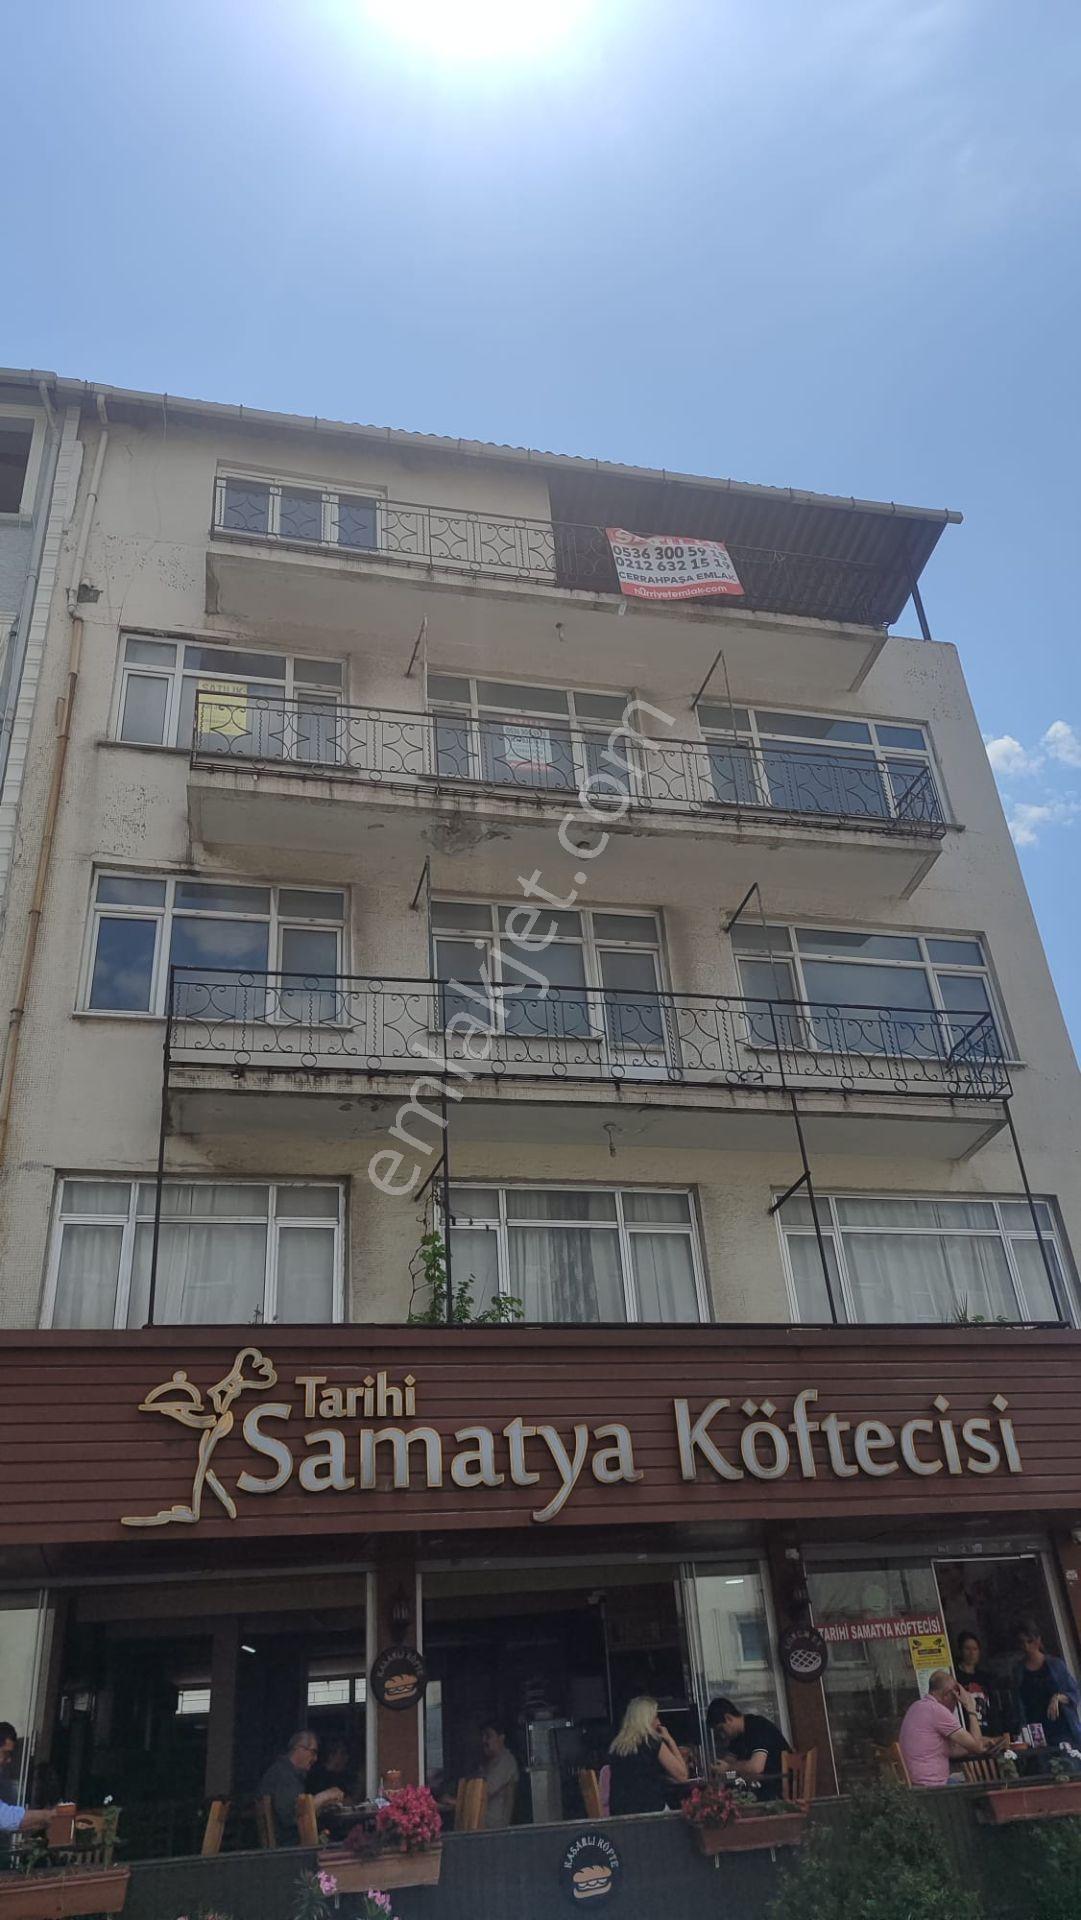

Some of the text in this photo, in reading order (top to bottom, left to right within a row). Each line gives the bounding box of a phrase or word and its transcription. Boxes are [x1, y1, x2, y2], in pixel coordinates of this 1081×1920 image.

[613, 545, 651, 560] 0536
[654, 546, 684, 560] 300
[688, 546, 706, 557] 59
[616, 556, 654, 571] 0212
[657, 560, 687, 571] 632
[691, 557, 710, 570] 15
[618, 571, 737, 584] CERRAHPAŞA EMLAK
[295, 1371, 416, 1418] Tarihi
[236, 1389, 1023, 1523] Samatya Köftecisi
[851, 1623, 894, 1639] SAMATYA
